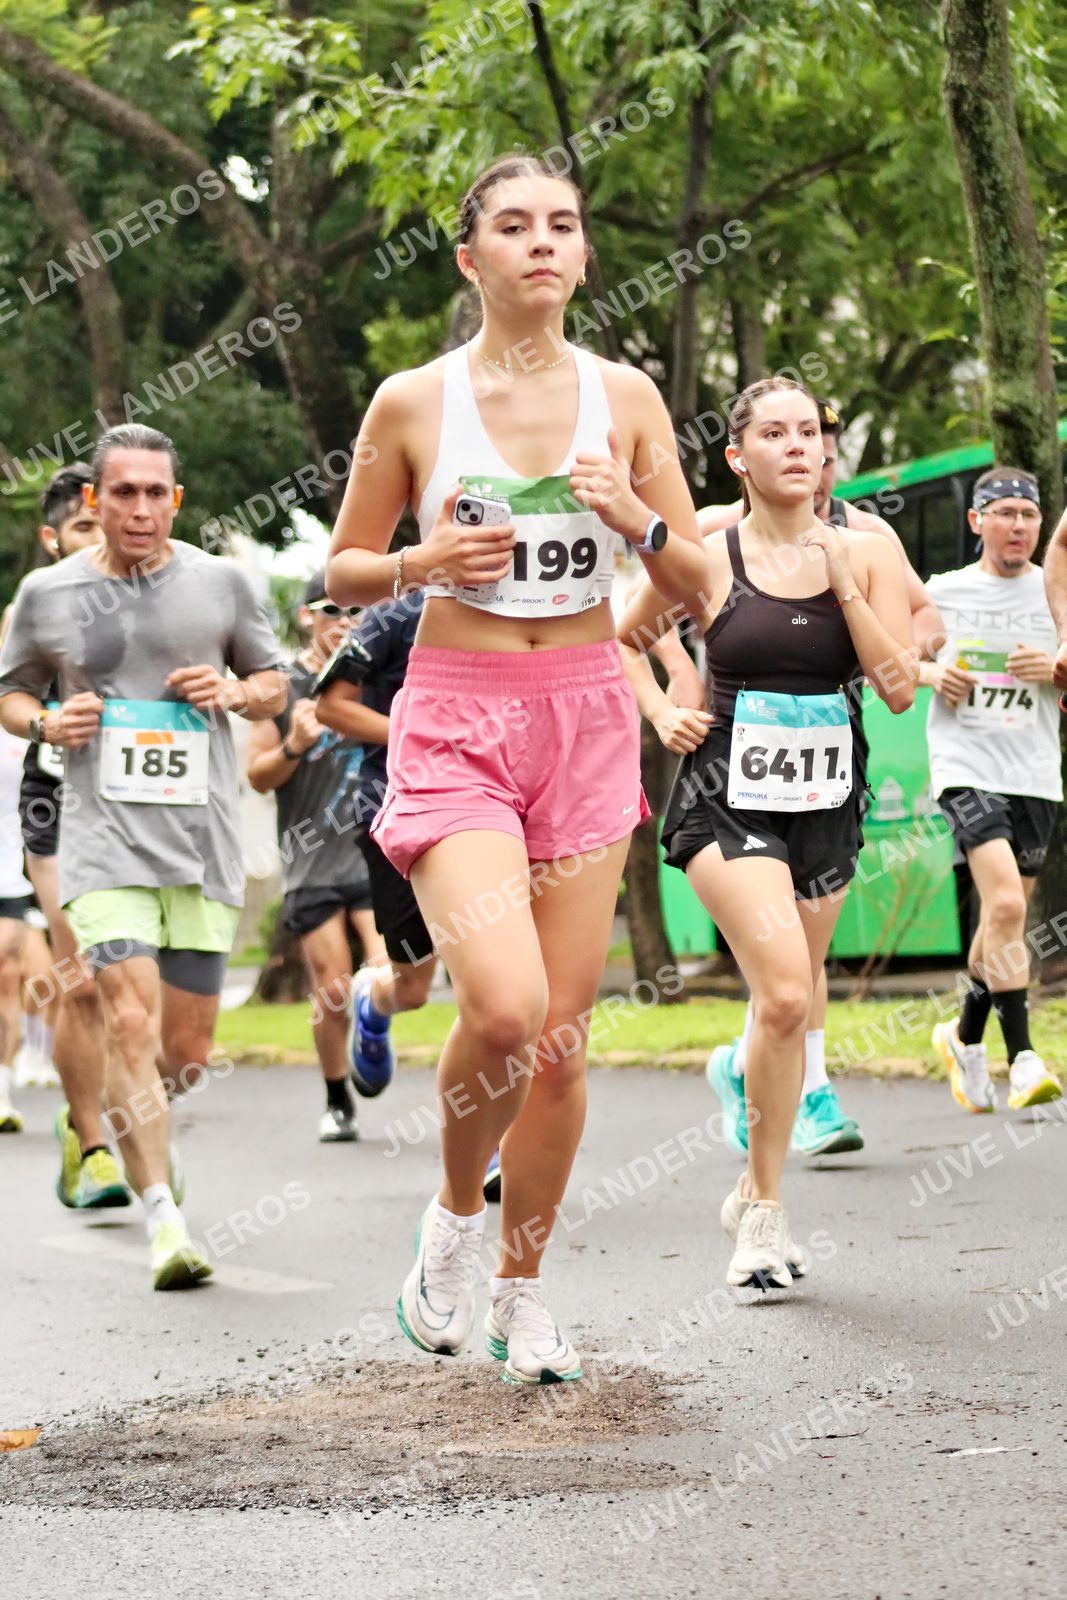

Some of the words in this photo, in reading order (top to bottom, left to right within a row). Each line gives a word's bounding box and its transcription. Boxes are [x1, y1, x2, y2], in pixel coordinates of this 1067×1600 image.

[791, 614, 808, 625] alo
[967, 685, 1033, 709] 1774
[121, 747, 188, 778] 185
[737, 791, 768, 800] PERDURA
